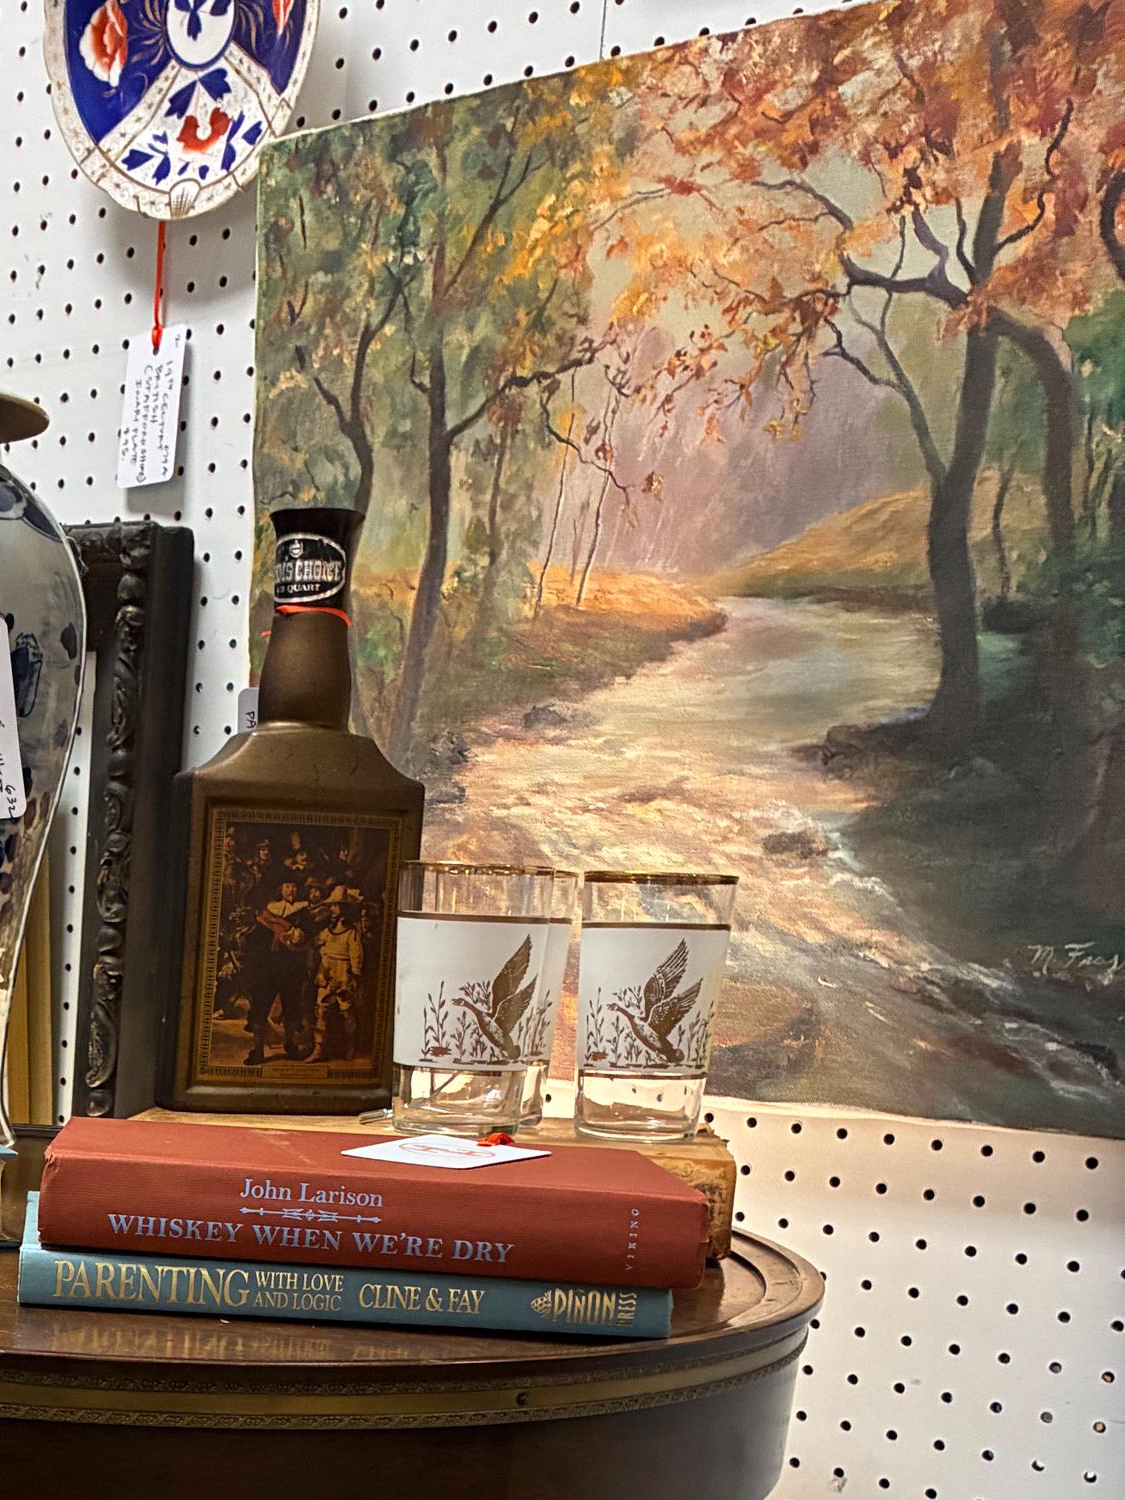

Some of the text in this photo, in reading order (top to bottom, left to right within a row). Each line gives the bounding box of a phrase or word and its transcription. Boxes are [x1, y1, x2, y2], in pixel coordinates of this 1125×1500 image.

[295, 558, 343, 583] CHOICE
[287, 584, 321, 594] QUART
[239, 1178, 384, 1207] John Larison
[107, 1213, 515, 1263] WHISKEY WHEN WE'RE DRY
[624, 1208, 641, 1271] VIKING
[53, 1259, 250, 1308] PARENTING
[254, 1270, 345, 1293] WITH LOVE
[252, 1291, 342, 1312] AND LOGIC
[358, 1283, 486, 1315] CLINE & FAY
